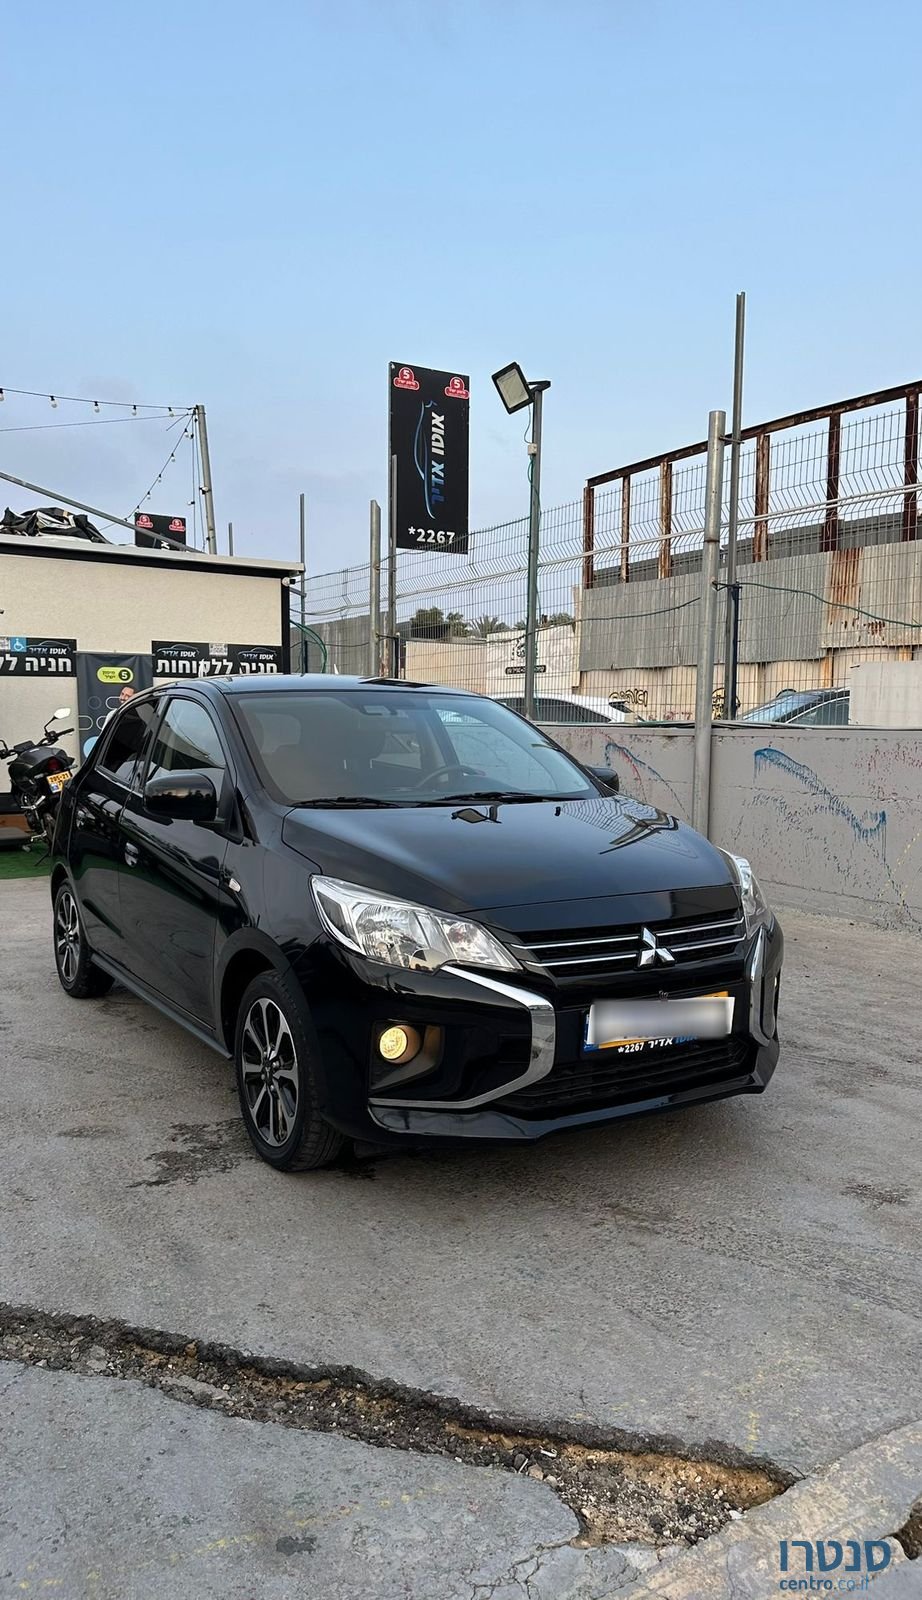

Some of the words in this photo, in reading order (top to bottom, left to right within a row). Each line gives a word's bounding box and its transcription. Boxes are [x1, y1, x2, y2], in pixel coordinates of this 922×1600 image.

[431, 411, 445, 456] אוטו
[431, 460, 445, 505] אדיר
[25, 657, 72, 672] חניה
[156, 658, 234, 678] ללקוחות
[239, 662, 278, 674] חניה
[121, 671, 128, 680] 5
[648, 1036, 674, 1049] אדיר
